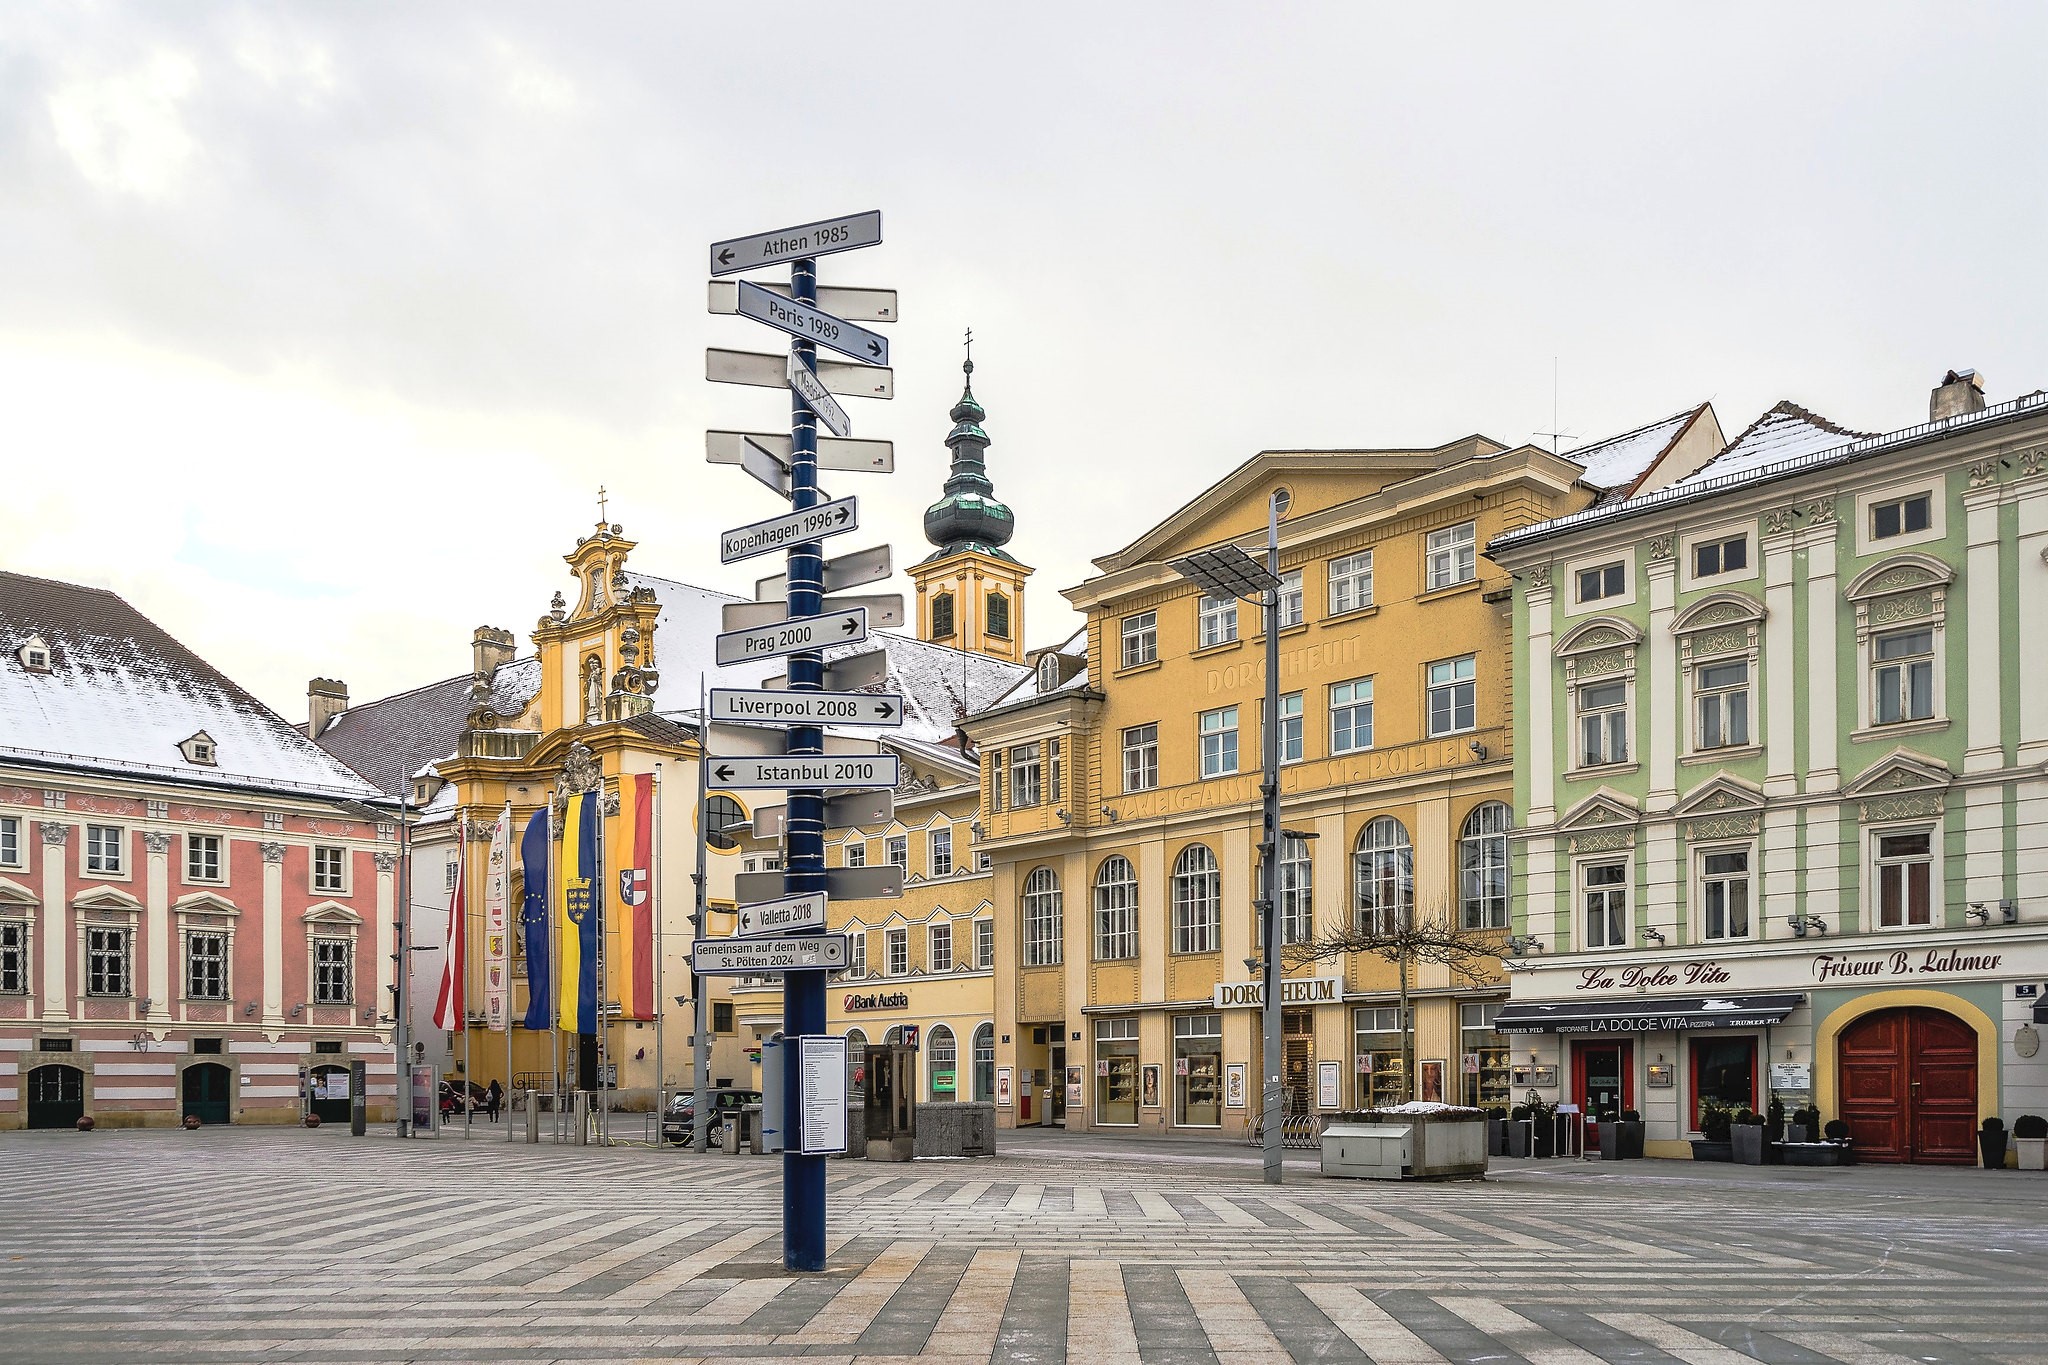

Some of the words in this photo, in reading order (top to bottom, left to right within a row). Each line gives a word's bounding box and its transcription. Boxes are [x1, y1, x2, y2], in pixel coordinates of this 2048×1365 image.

[763, 234, 809, 258] Athen
[812, 224, 850, 248] 1985
[769, 301, 805, 328] Paris
[808, 315, 841, 341] 1989
[726, 525, 800, 553] Kopenhagen
[803, 511, 833, 534] 1996
[745, 635, 775, 652] Prag
[779, 627, 812, 647] 2000
[728, 696, 812, 718] Liverpool
[815, 699, 858, 718] 2008
[756, 764, 830, 781] Istanbul
[833, 763, 874, 780] 2010
[759, 910, 792, 927] Valletta
[792, 902, 812, 921] 2018
[696, 945, 754, 955] Gemeinsam
[755, 942, 772, 953] auf
[774, 942, 796, 953] dem
[798, 940, 820, 953] Weg
[721, 957, 735, 968] St.
[736, 954, 768, 968] Pölten
[769, 955, 794, 967] 2024
[1812, 955, 1884, 983] Friseur
[1889, 950, 1914, 975] B.
[1918, 949, 2002, 973] Lahmer
[1576, 966, 1615, 990] La
[1619, 965, 1678, 988] Dolce
[1683, 961, 1731, 985] Vita
[854, 993, 877, 1009] Bank
[877, 991, 908, 1007] Austria
[1221, 979, 1336, 1005] DOROHEUM
[2022, 985, 2029, 994] 5
[1555, 1025, 1589, 1033] RISTORANTE
[1590, 1019, 1607, 1032] LA
[1610, 1018, 1658, 1031] DOLCE
[1660, 1017, 1689, 1030] VITA
[1689, 1020, 1715, 1028] PIZZERIA
